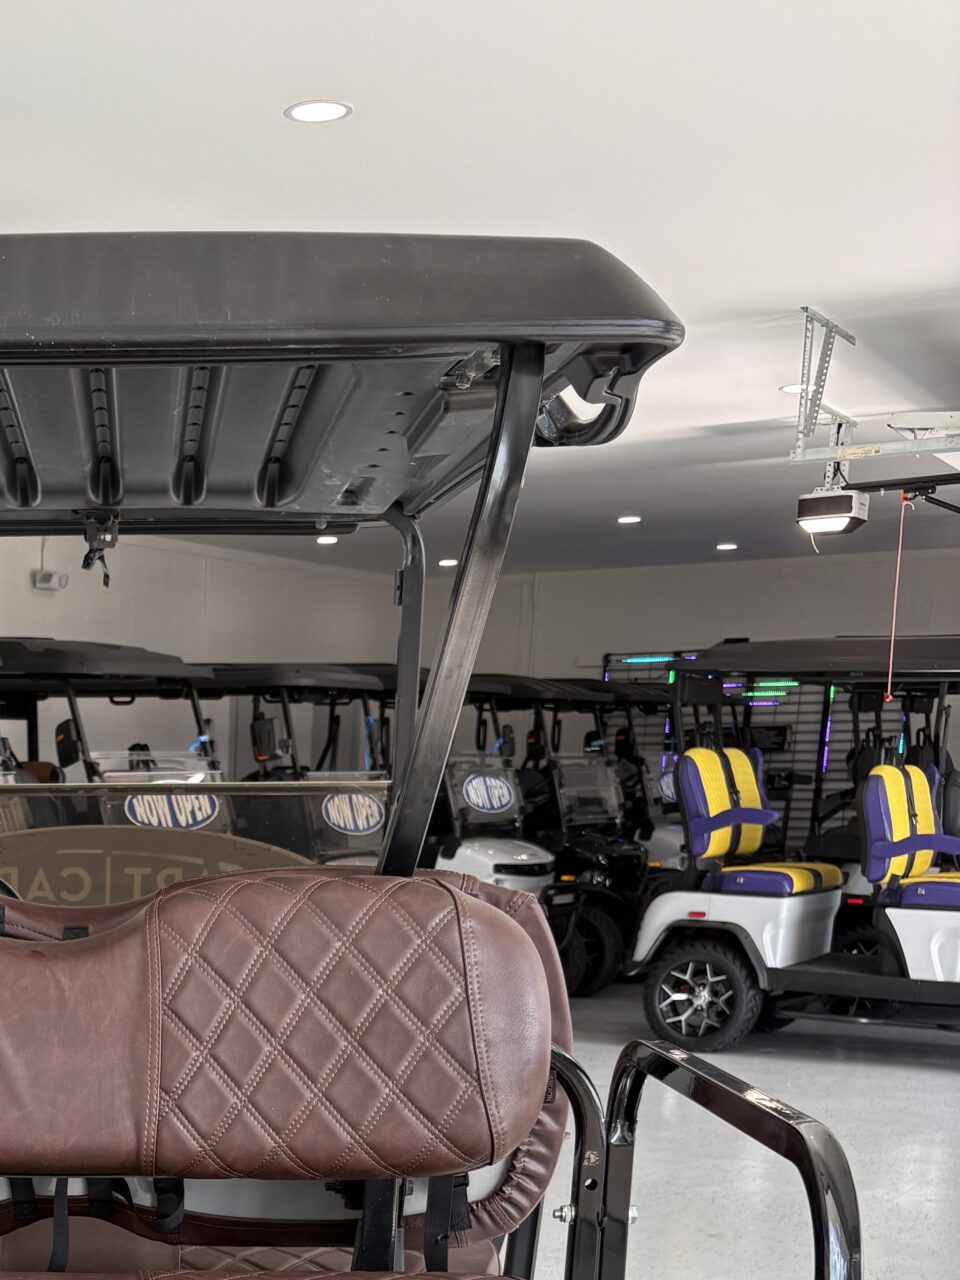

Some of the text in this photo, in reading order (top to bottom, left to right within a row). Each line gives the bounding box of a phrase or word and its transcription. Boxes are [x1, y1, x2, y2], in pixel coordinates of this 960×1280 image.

[132, 795, 173, 828] NOW
[327, 794, 380, 831] NOW OPEN
